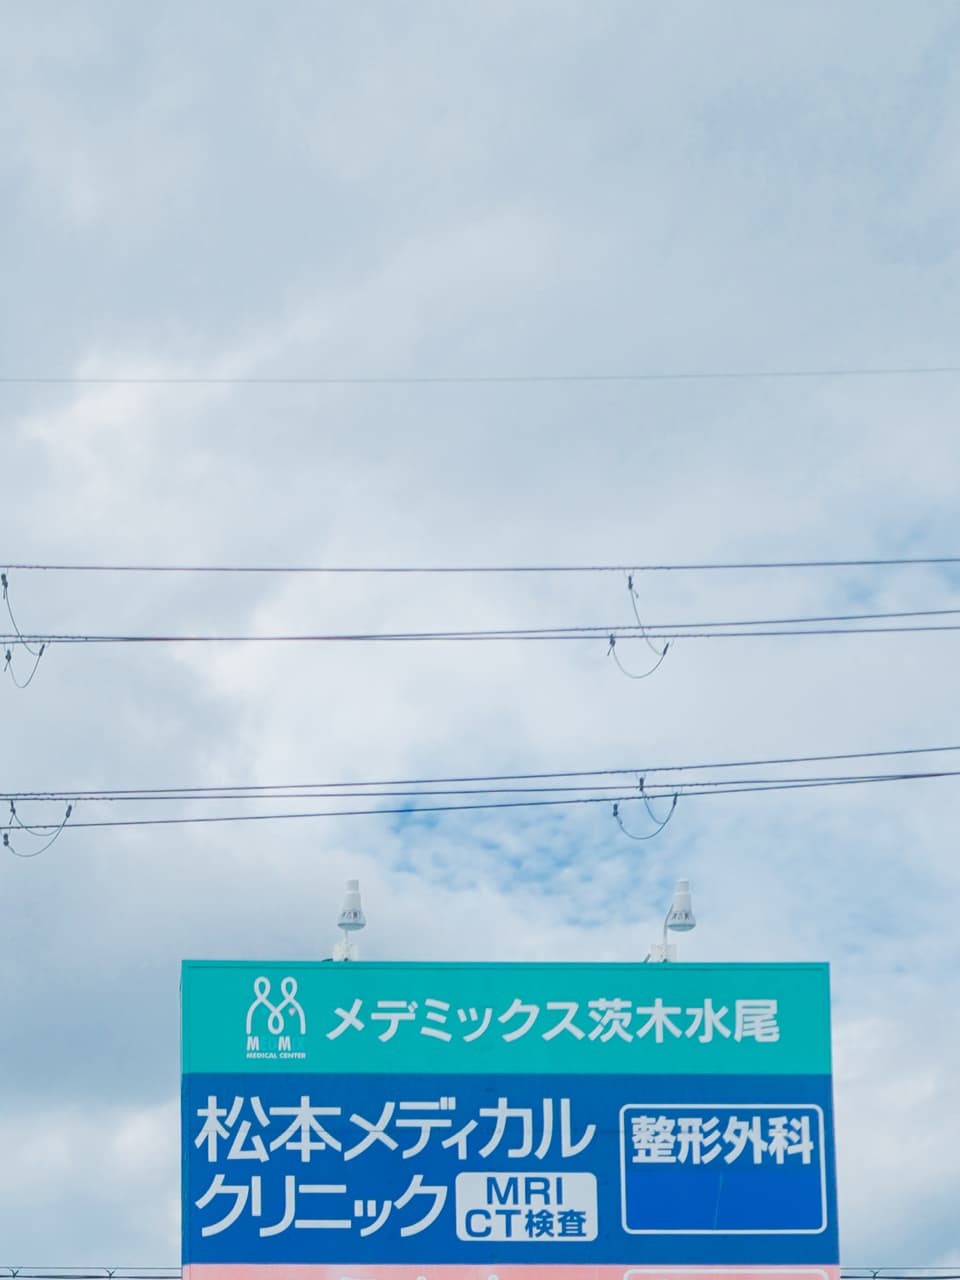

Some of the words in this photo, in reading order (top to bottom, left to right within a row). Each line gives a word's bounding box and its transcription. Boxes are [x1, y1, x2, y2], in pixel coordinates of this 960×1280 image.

[326, 998, 781, 1044] メデミックス茨木水尾
[195, 1096, 596, 1162] 松本メディカル
[631, 1116, 814, 1165] 整形外科
[195, 1174, 448, 1237] クリニック
[486, 1177, 565, 1206] MRI
[464, 1208, 588, 1238] CT検査
